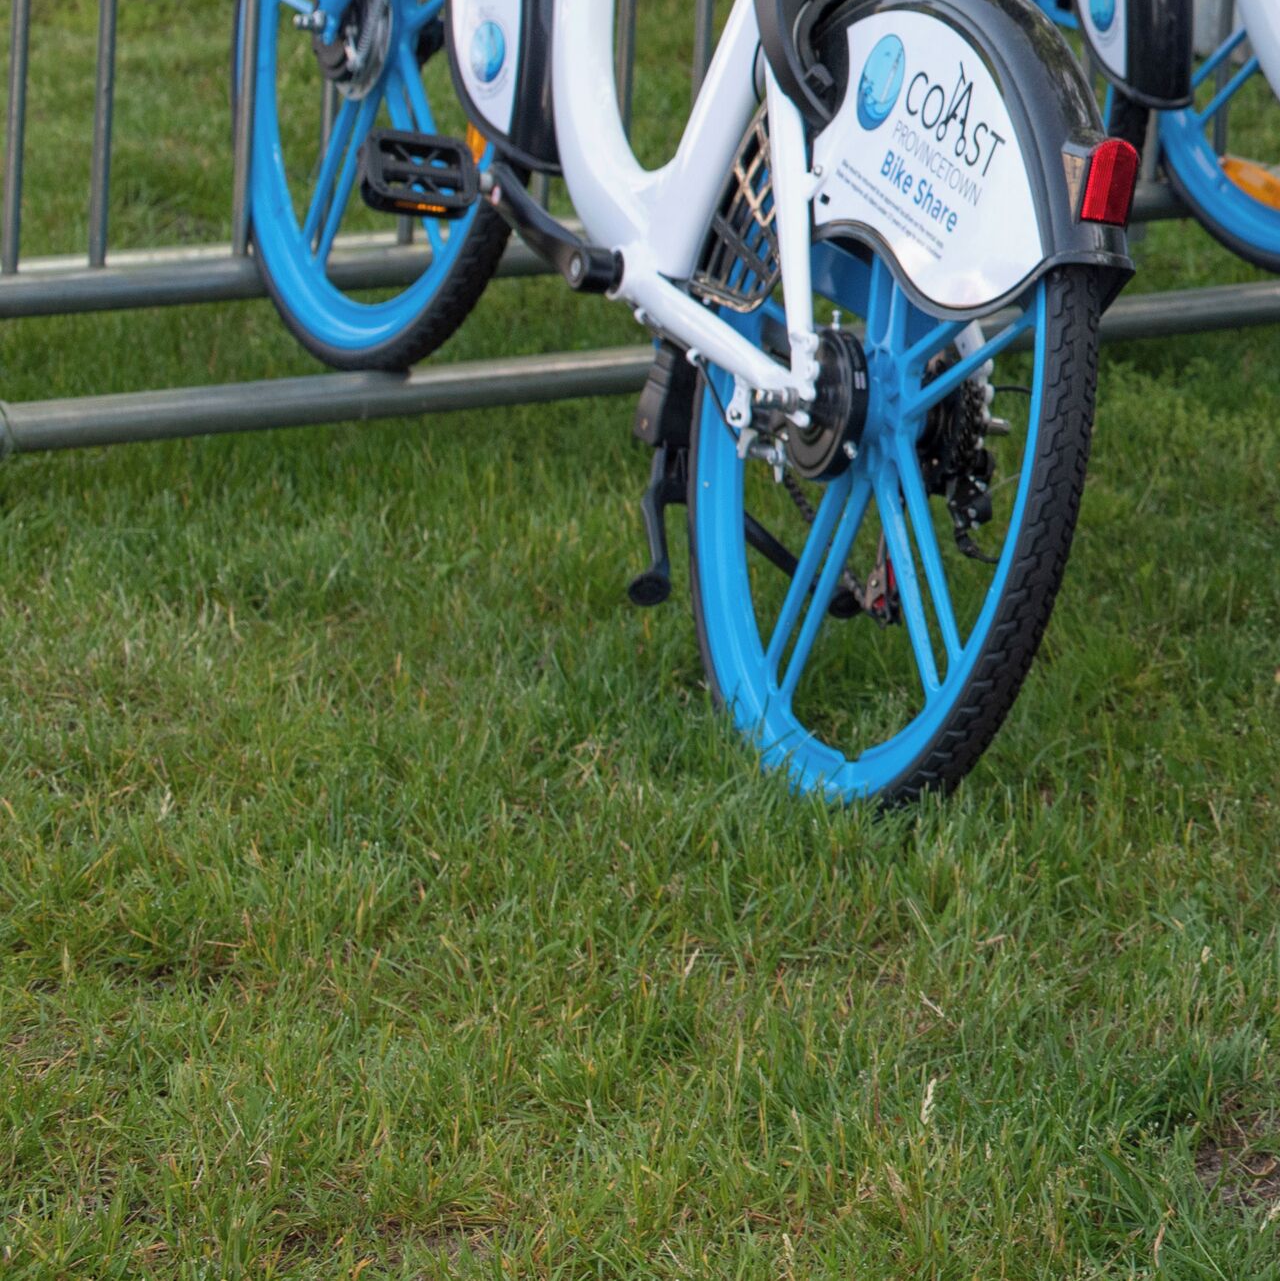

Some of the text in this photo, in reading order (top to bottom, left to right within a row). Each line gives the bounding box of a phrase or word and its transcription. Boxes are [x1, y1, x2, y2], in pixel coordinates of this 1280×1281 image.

[892, 119, 983, 207] PROVINCETOWN
[905, 61, 1006, 178] COAST
[880, 149, 913, 196] Bike
[913, 178, 959, 234] Share
